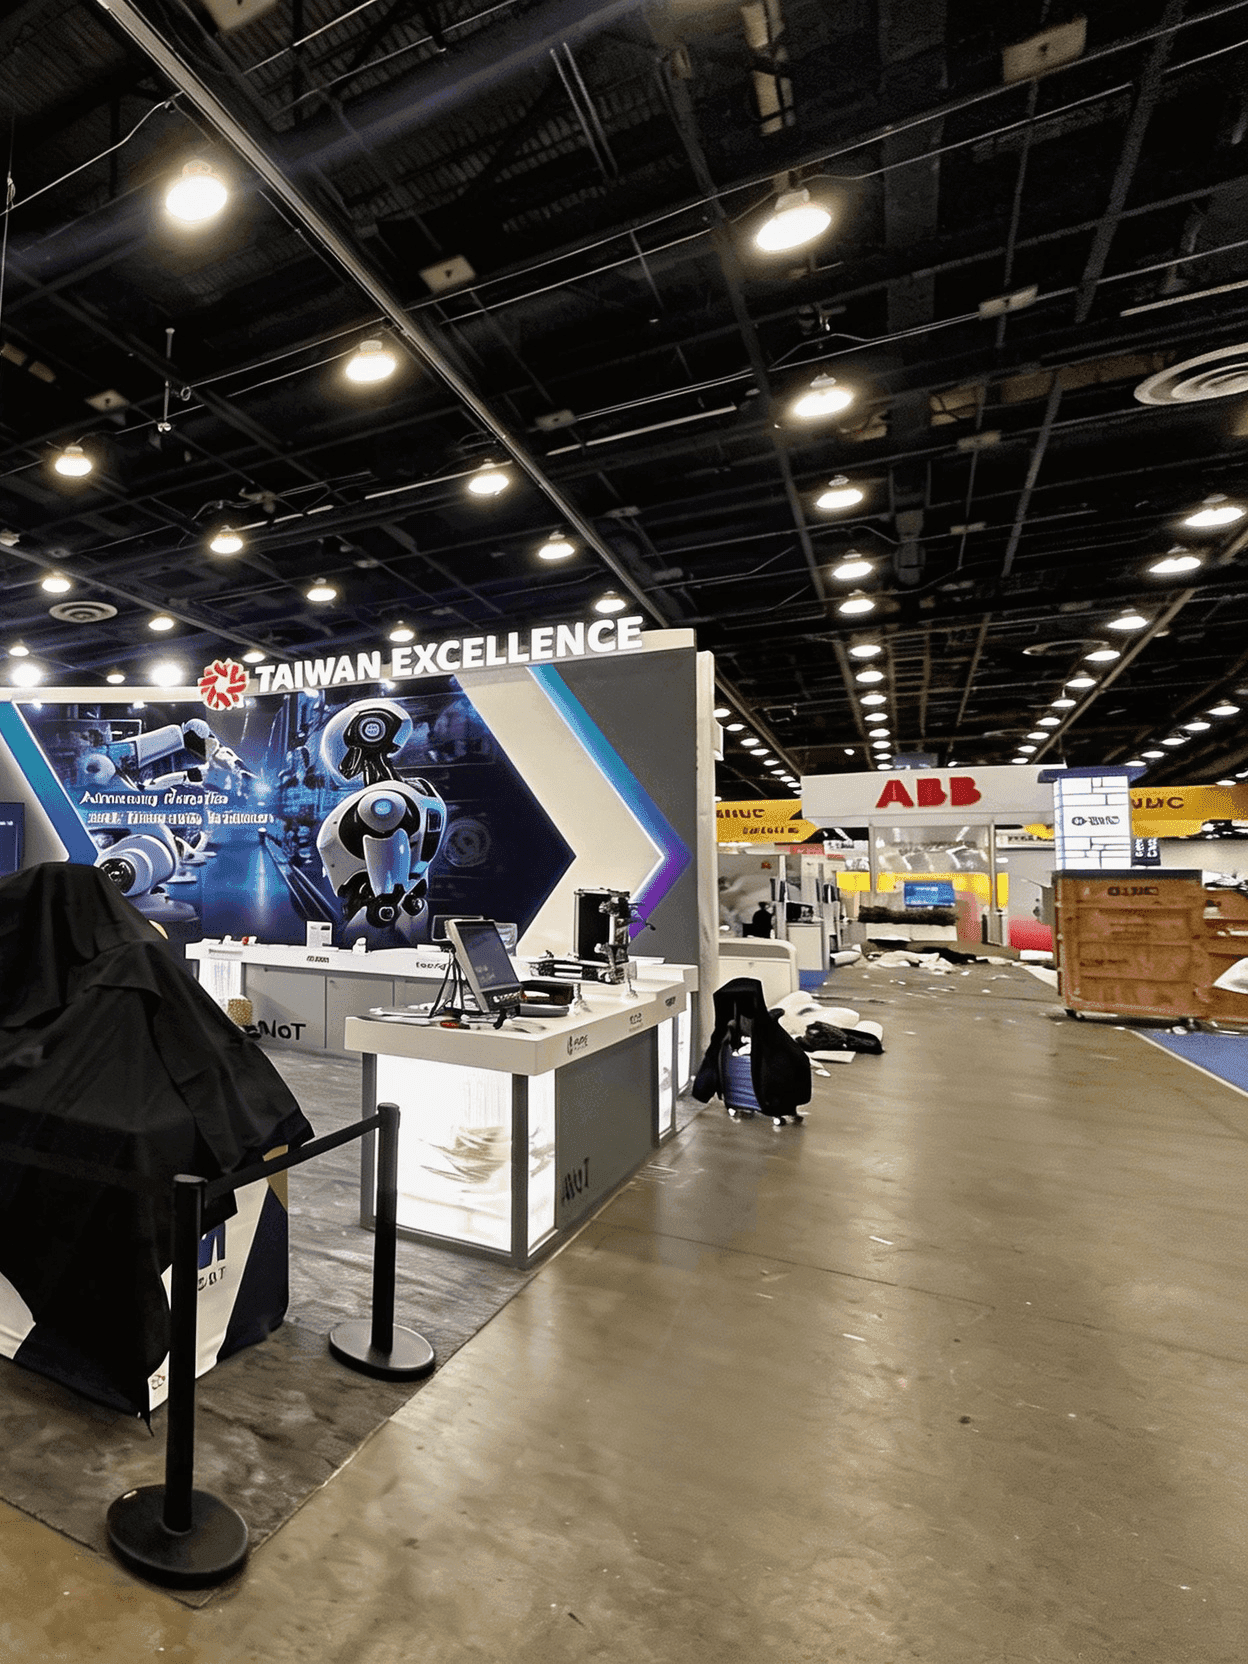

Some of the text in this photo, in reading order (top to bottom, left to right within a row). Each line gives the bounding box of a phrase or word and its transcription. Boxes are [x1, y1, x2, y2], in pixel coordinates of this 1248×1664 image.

[254, 615, 644, 694] TAIWAN EXCELLENCE
[875, 776, 982, 809] ABB
